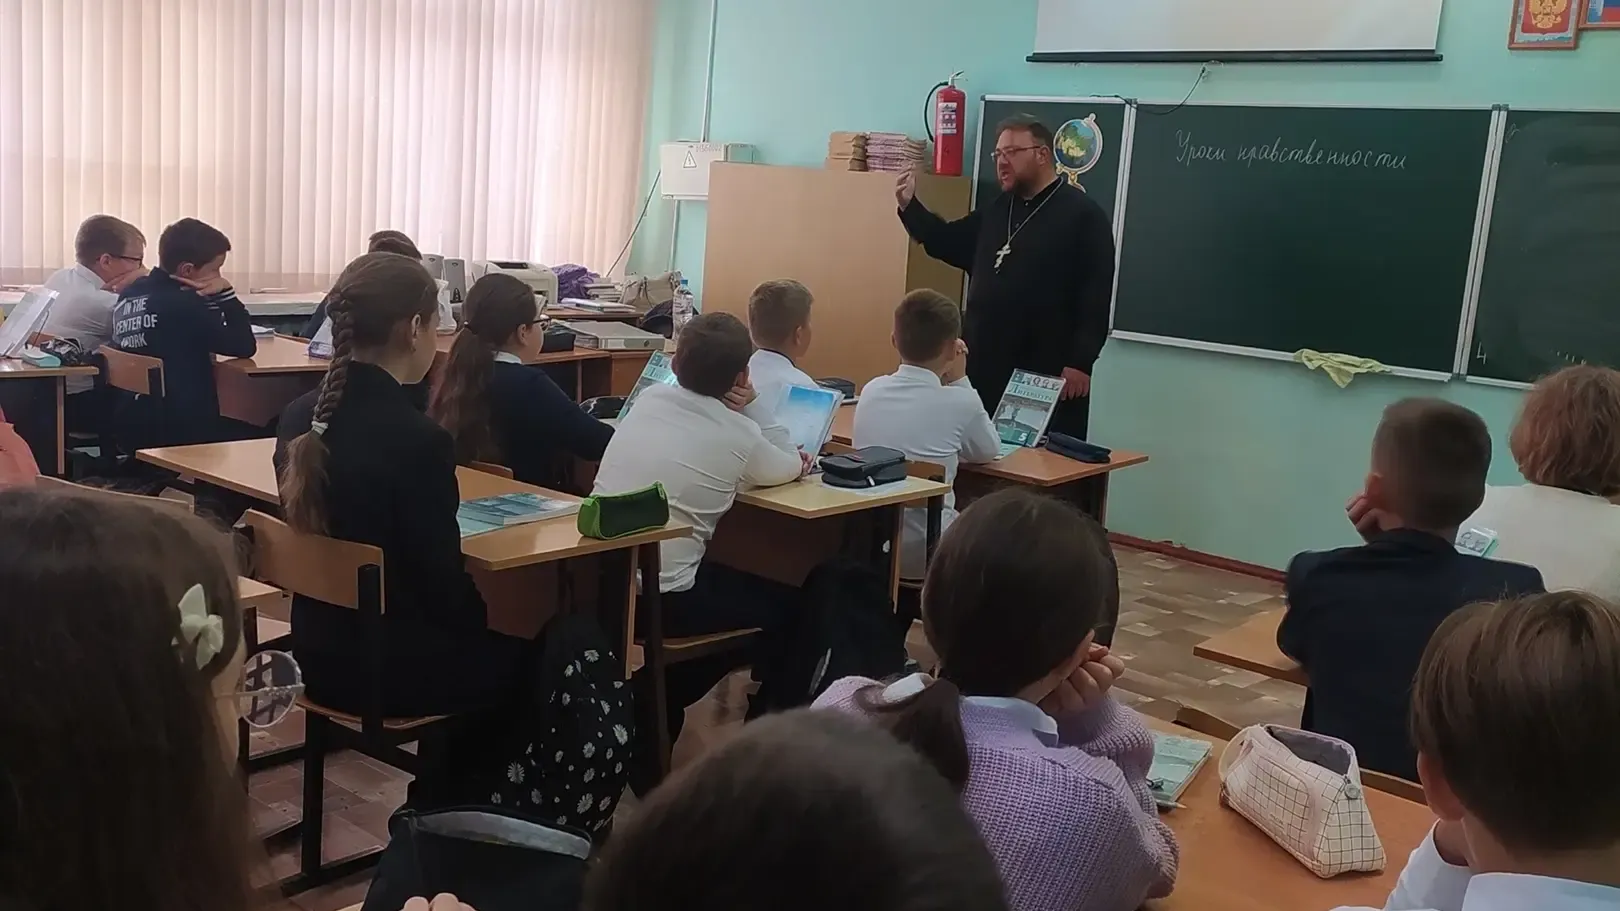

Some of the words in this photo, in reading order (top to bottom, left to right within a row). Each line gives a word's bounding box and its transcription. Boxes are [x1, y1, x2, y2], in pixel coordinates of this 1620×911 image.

[1176, 129, 1226, 167] Уроки
[1238, 136, 1405, 170] нравственности
[123, 302, 132, 315] IN
[132, 297, 148, 313] THE
[143, 314, 158, 328] OF
[1476, 341, 1487, 365] 4
